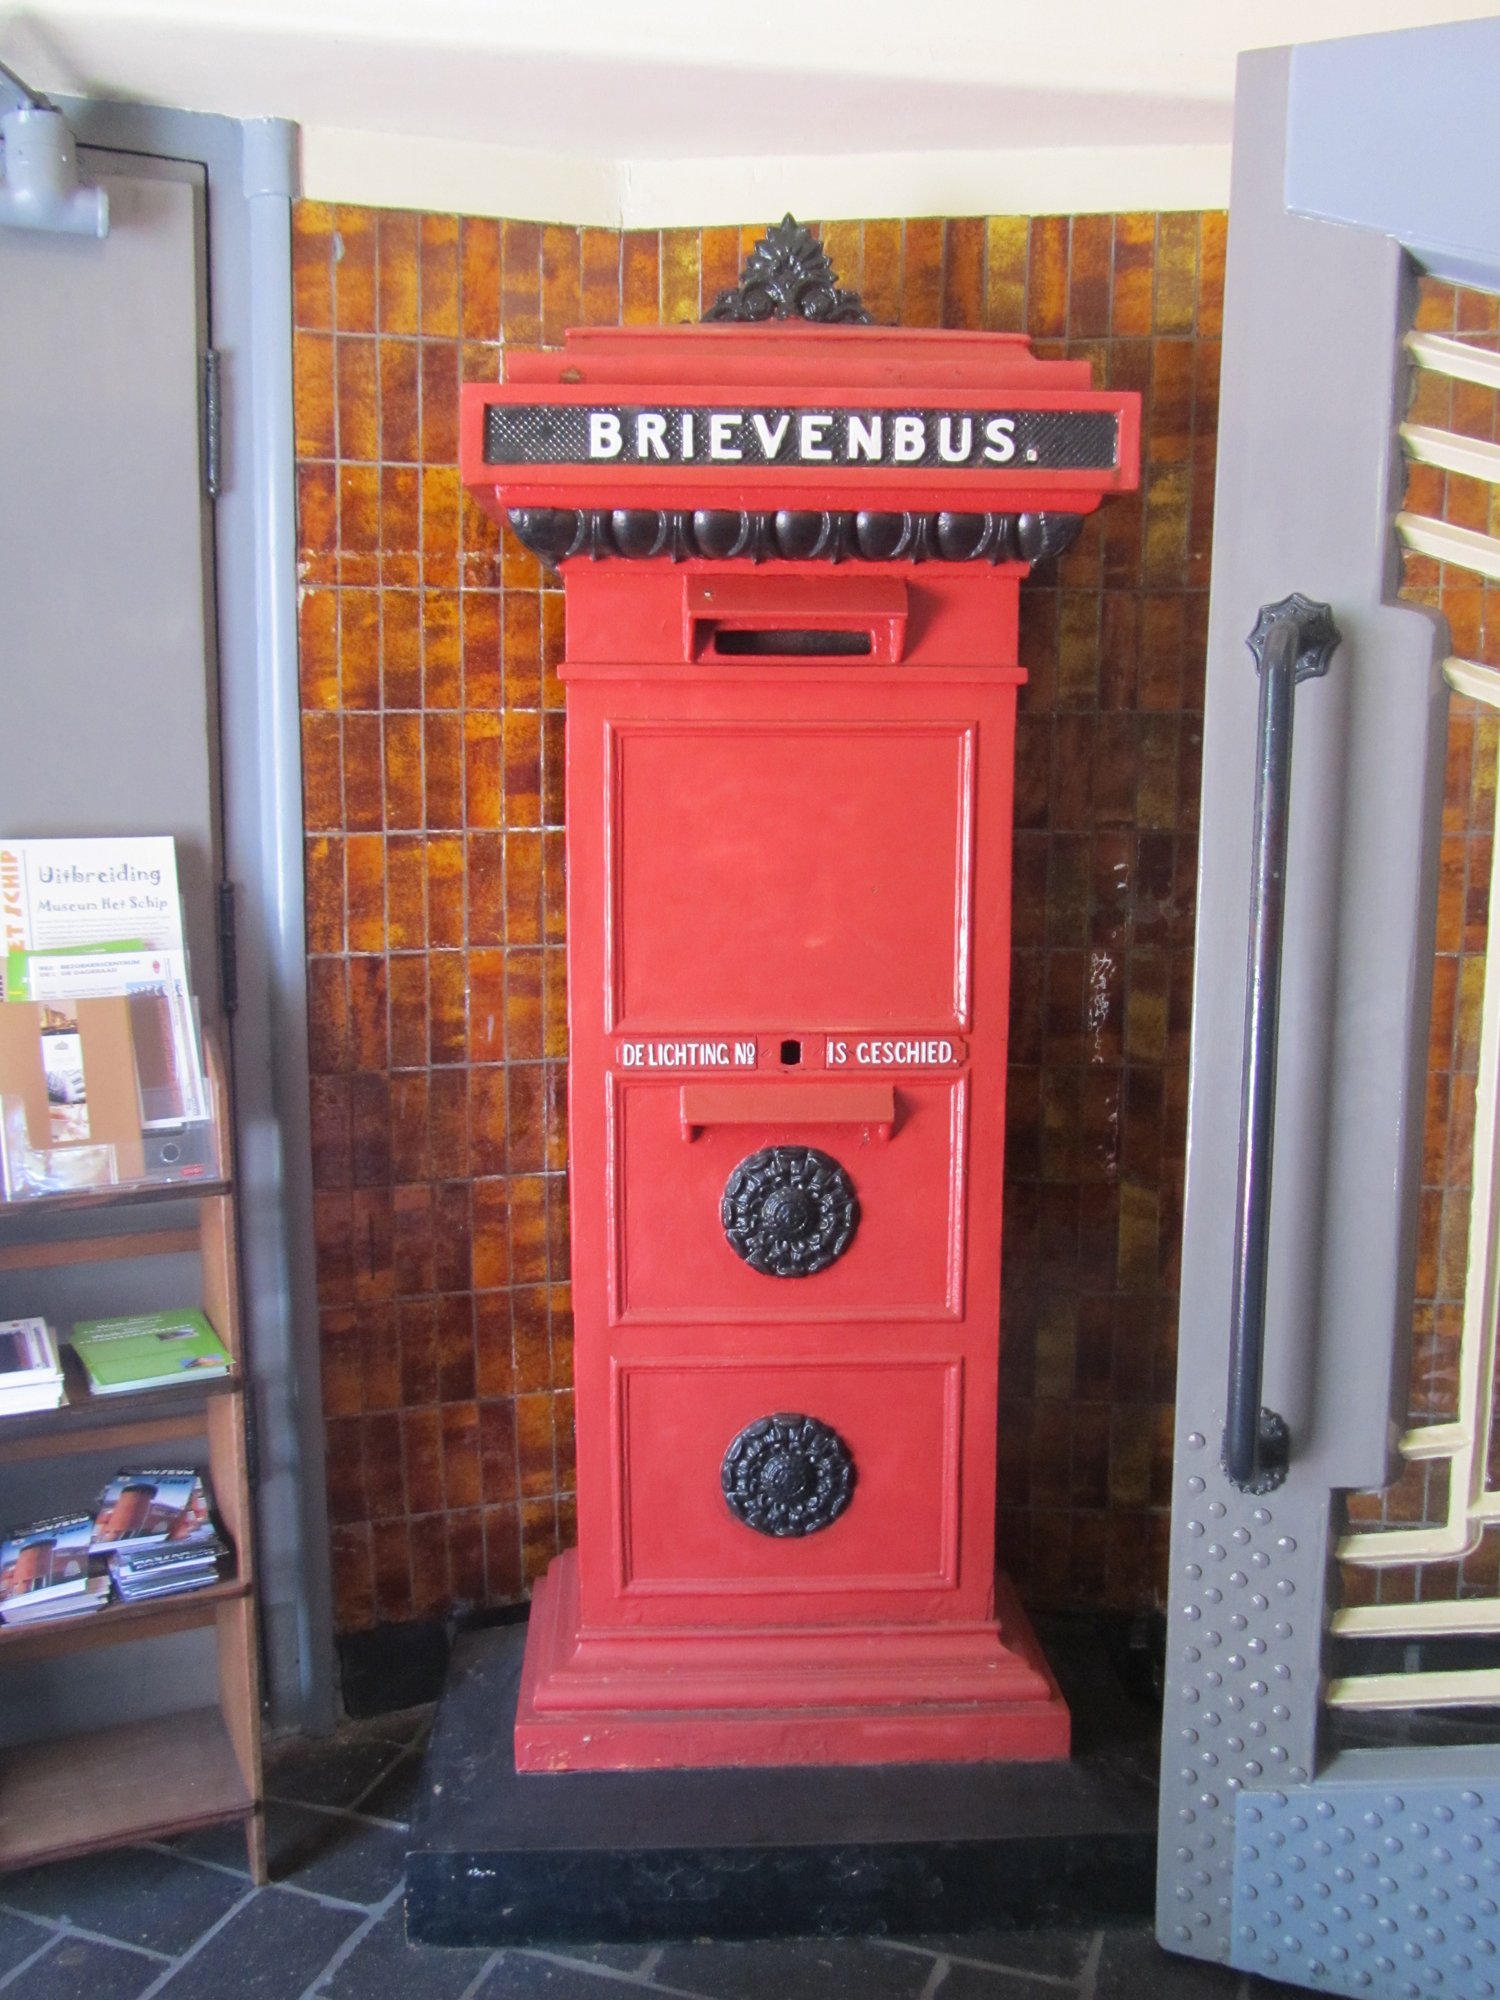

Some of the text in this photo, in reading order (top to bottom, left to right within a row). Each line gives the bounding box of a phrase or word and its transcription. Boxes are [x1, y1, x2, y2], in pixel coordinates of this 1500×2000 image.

[588, 412, 1038, 463] BRIEVENBUS.
[39, 863, 161, 886] Uitbreiding
[37, 895, 168, 912] Museum Het Schip
[622, 1043, 645, 1067] DE
[647, 1042, 729, 1067] LICHTING
[828, 1041, 958, 1065] IS GESCHIED.
